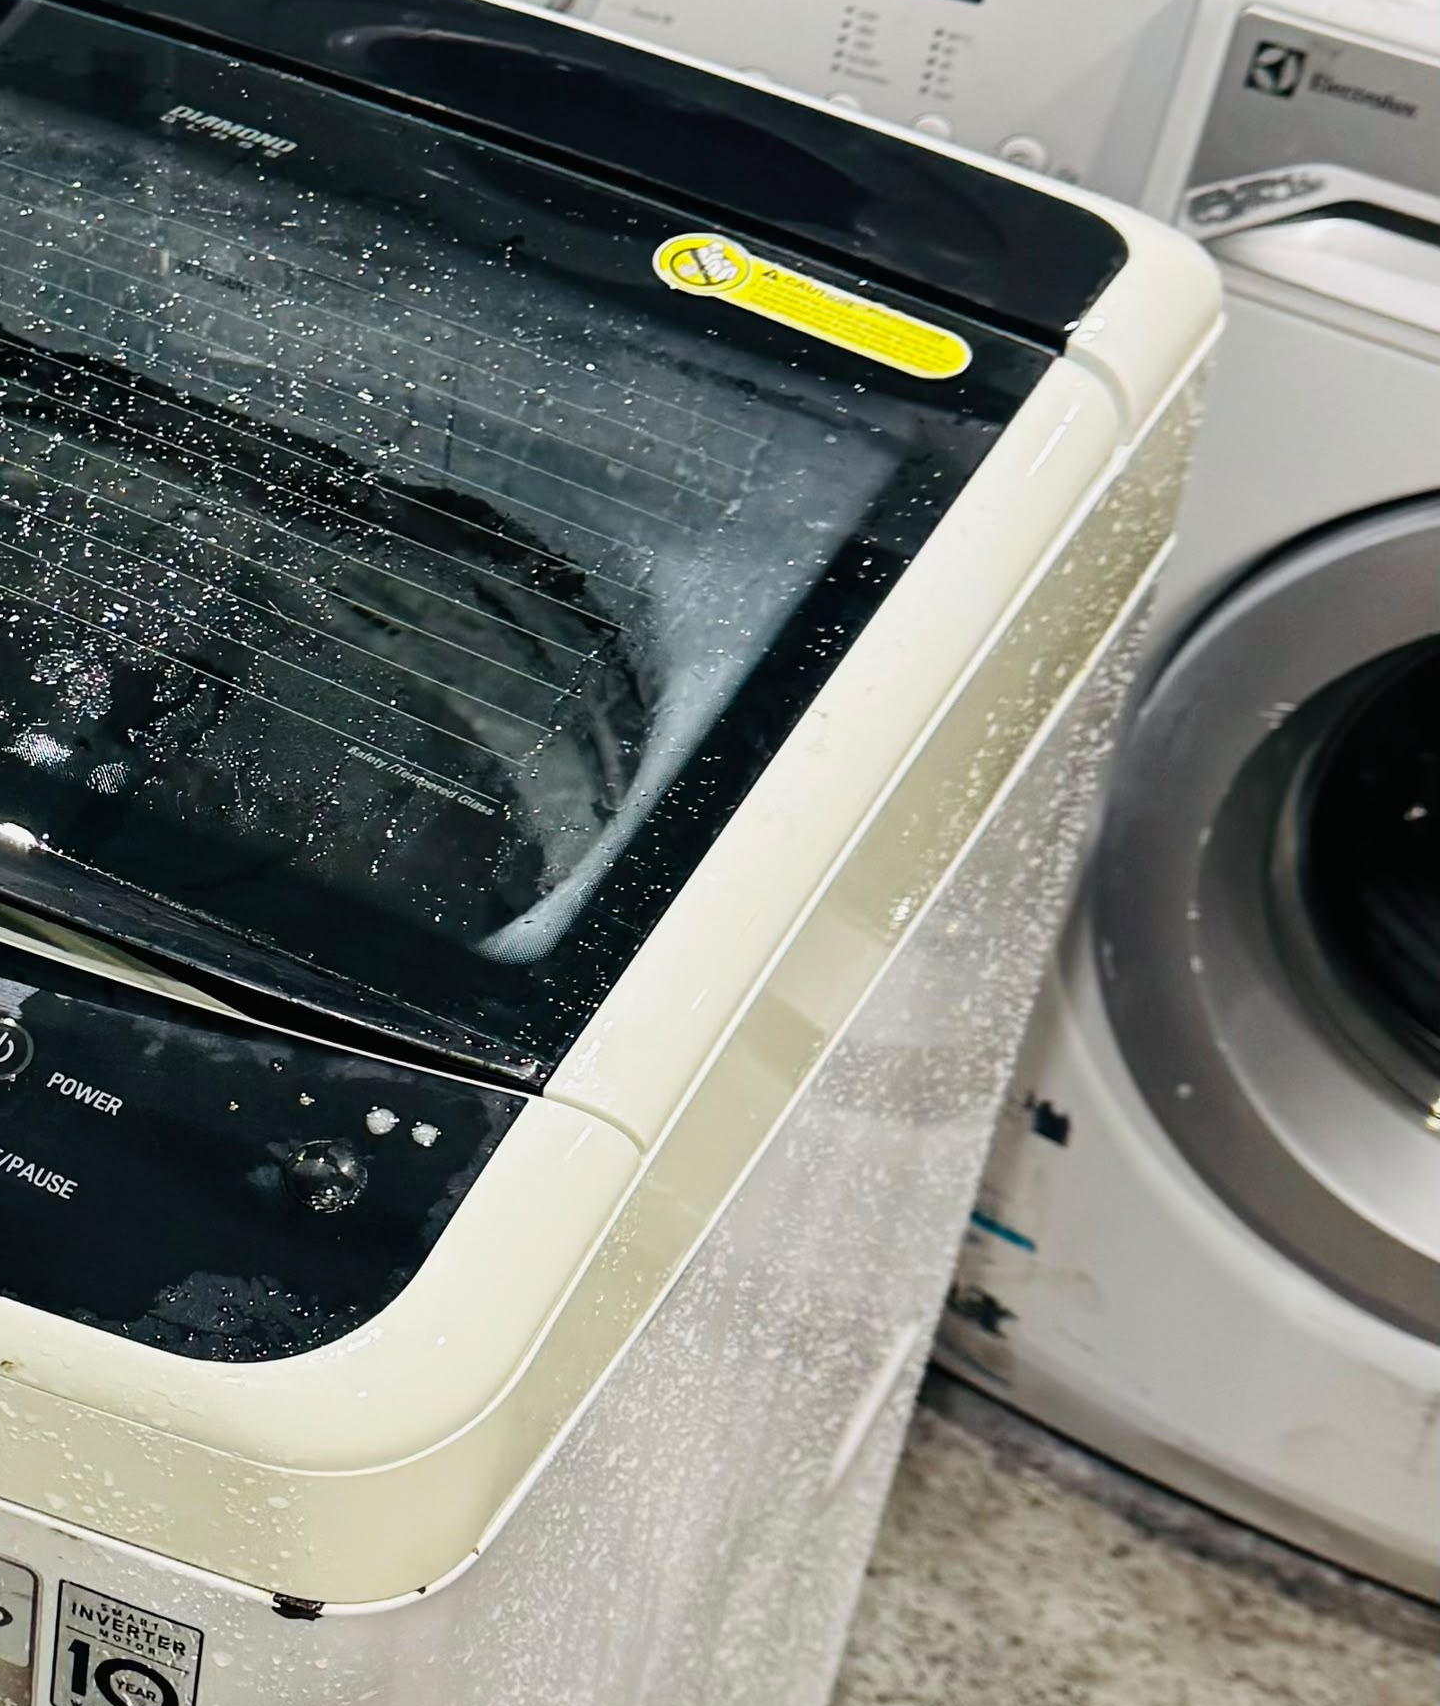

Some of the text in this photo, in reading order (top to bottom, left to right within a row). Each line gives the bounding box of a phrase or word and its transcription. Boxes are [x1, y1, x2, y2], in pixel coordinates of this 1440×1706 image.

[168, 105, 298, 153] DIAMOND
[47, 1071, 123, 1116] POWER
[71, 1602, 186, 1656] INVERTER
[101, 1603, 159, 1631] SMART
[98, 1628, 156, 1656] MOTOR
[116, 1677, 157, 1702] YEAR
